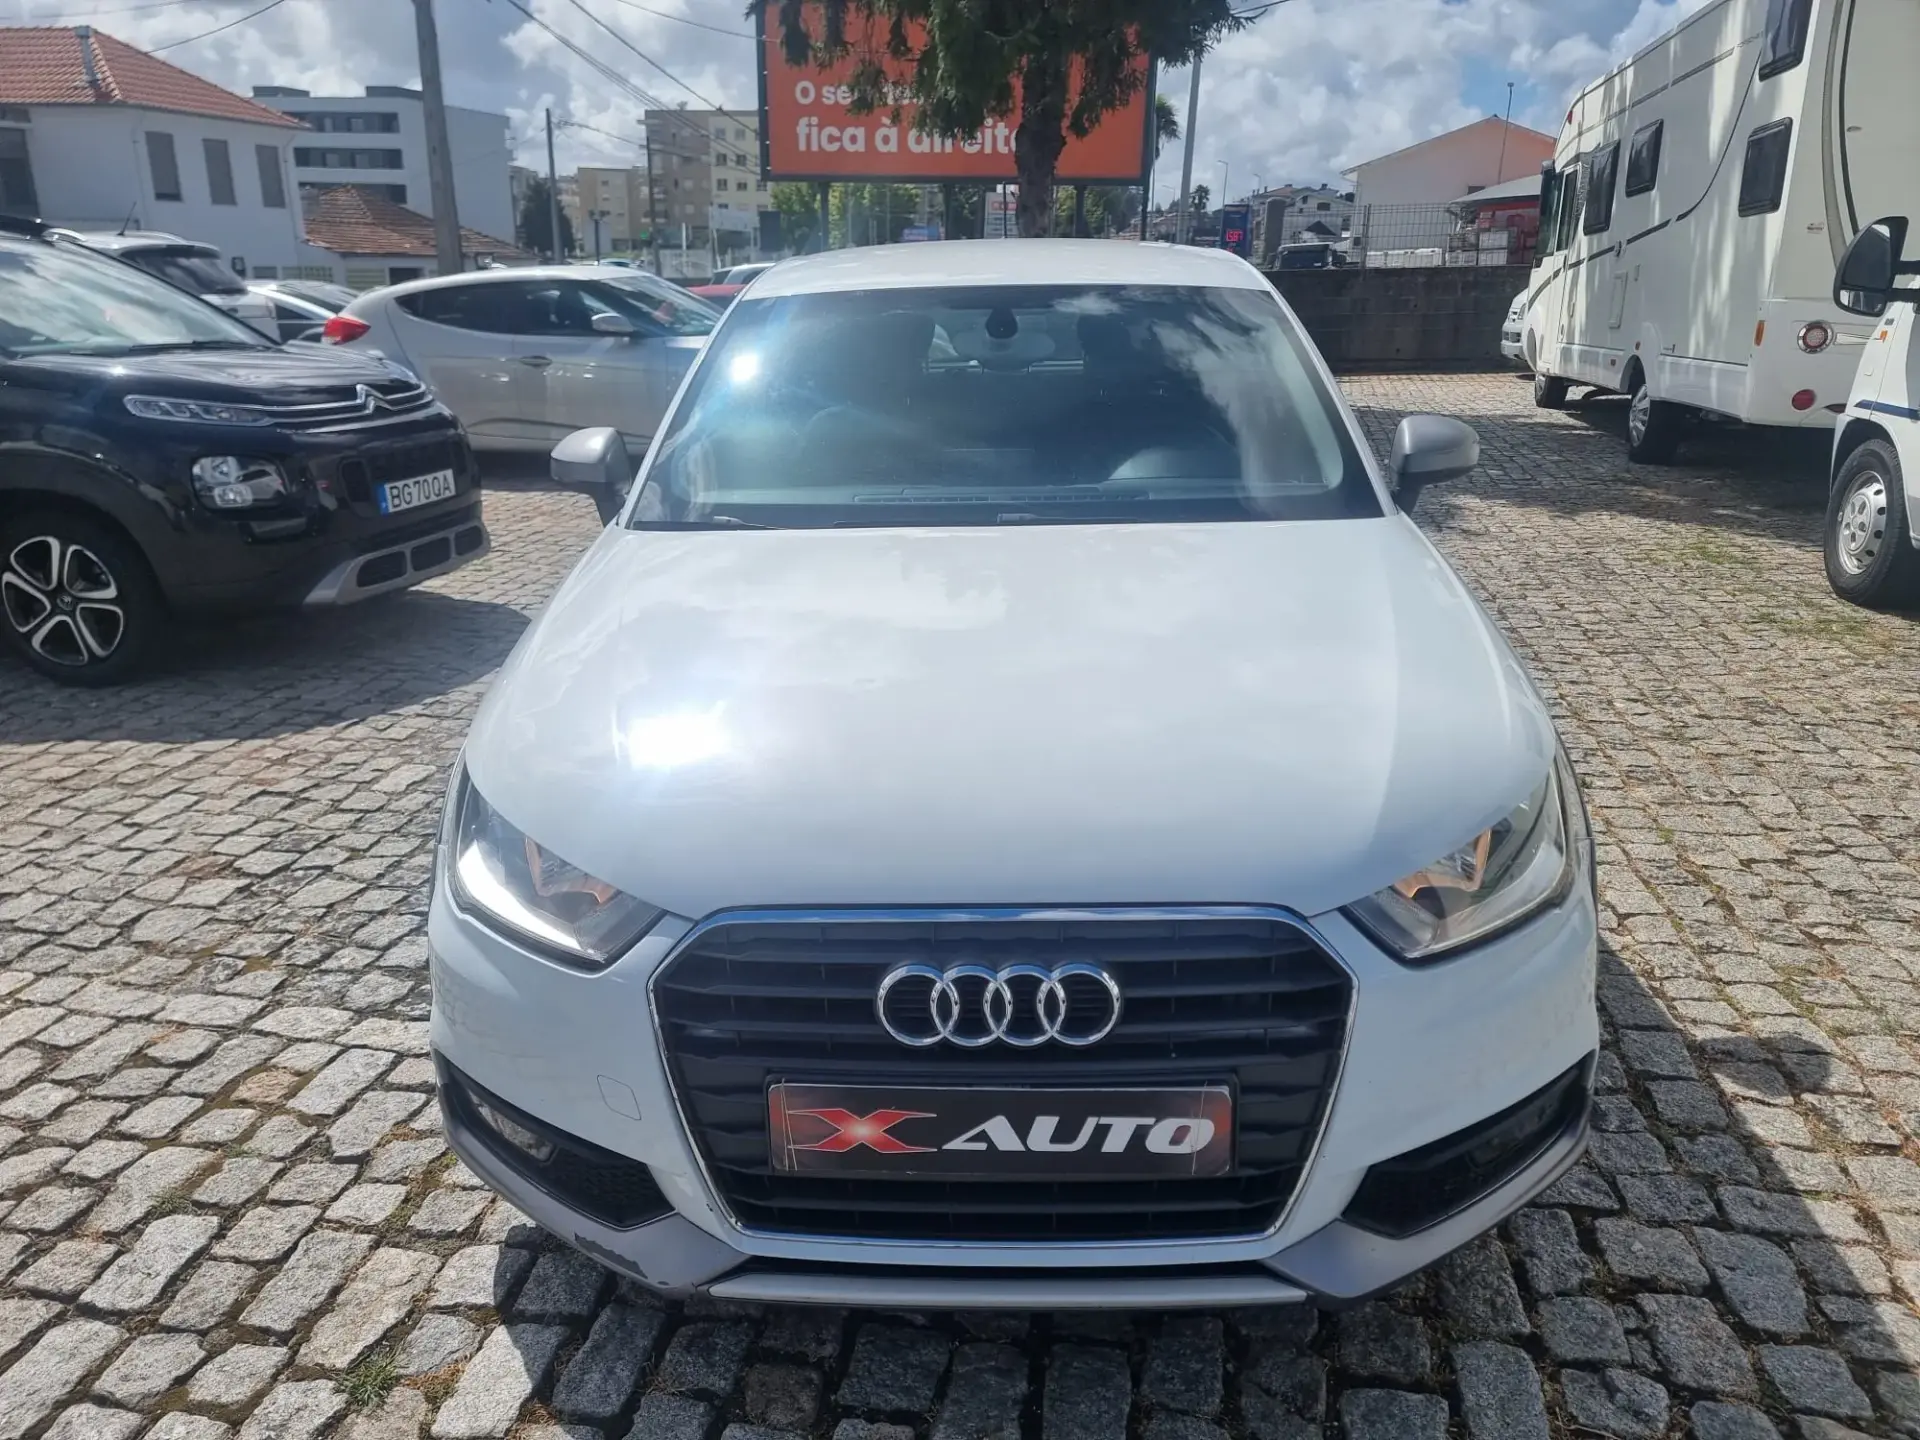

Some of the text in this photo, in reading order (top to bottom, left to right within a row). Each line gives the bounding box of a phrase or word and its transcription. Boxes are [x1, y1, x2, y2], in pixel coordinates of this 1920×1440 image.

[795, 81, 815, 105] O
[797, 116, 865, 152] fica
[875, 116, 898, 153] à
[942, 1115, 1215, 1154] AUTO
